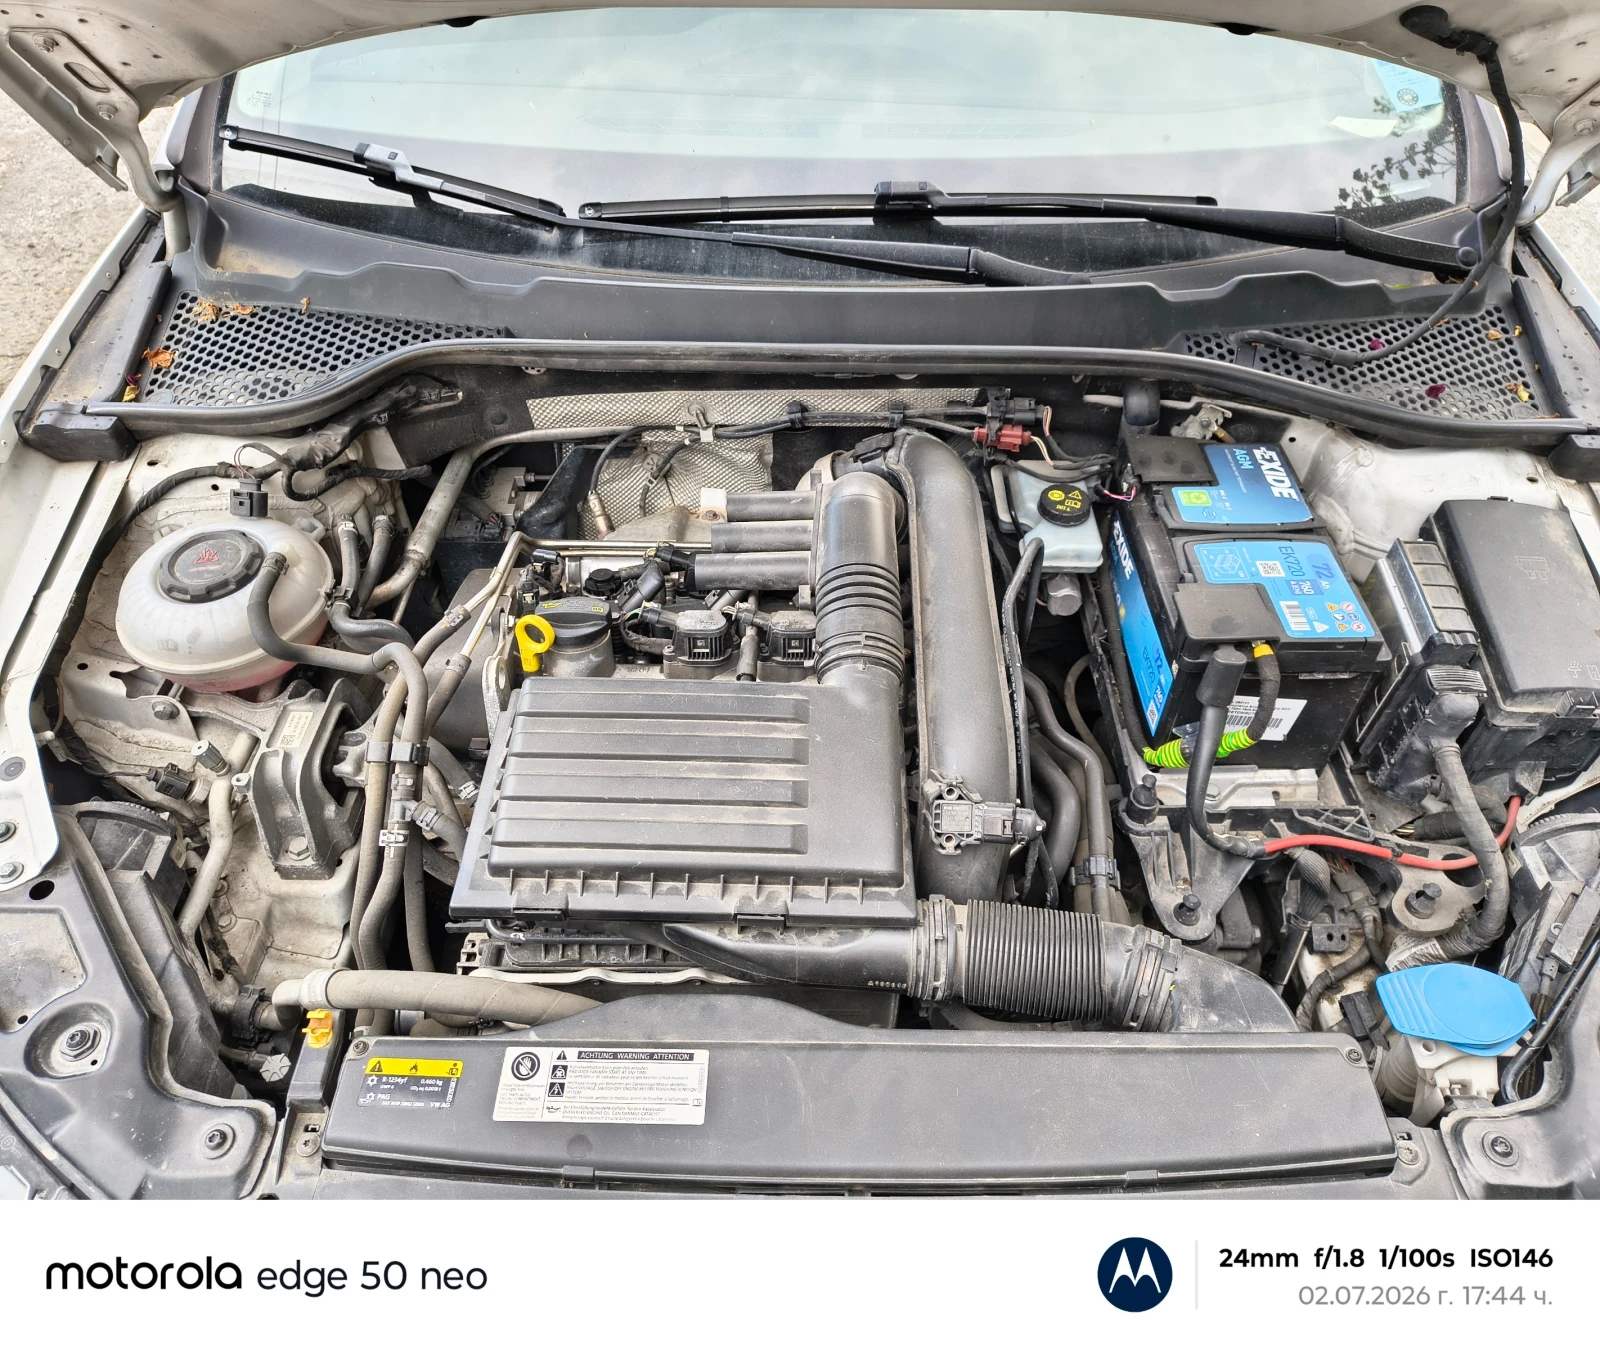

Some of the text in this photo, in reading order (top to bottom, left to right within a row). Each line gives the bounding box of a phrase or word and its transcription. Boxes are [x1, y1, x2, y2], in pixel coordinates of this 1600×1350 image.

[1233, 448, 1254, 469] AGM
[1253, 447, 1298, 500] EXIDE
[1113, 520, 1134, 580] EXIDE
[1279, 546, 1305, 577] EK720
[1312, 563, 1335, 579] 72
[1299, 580, 1315, 595] 760
[382, 1076, 408, 1084] R-1234yf
